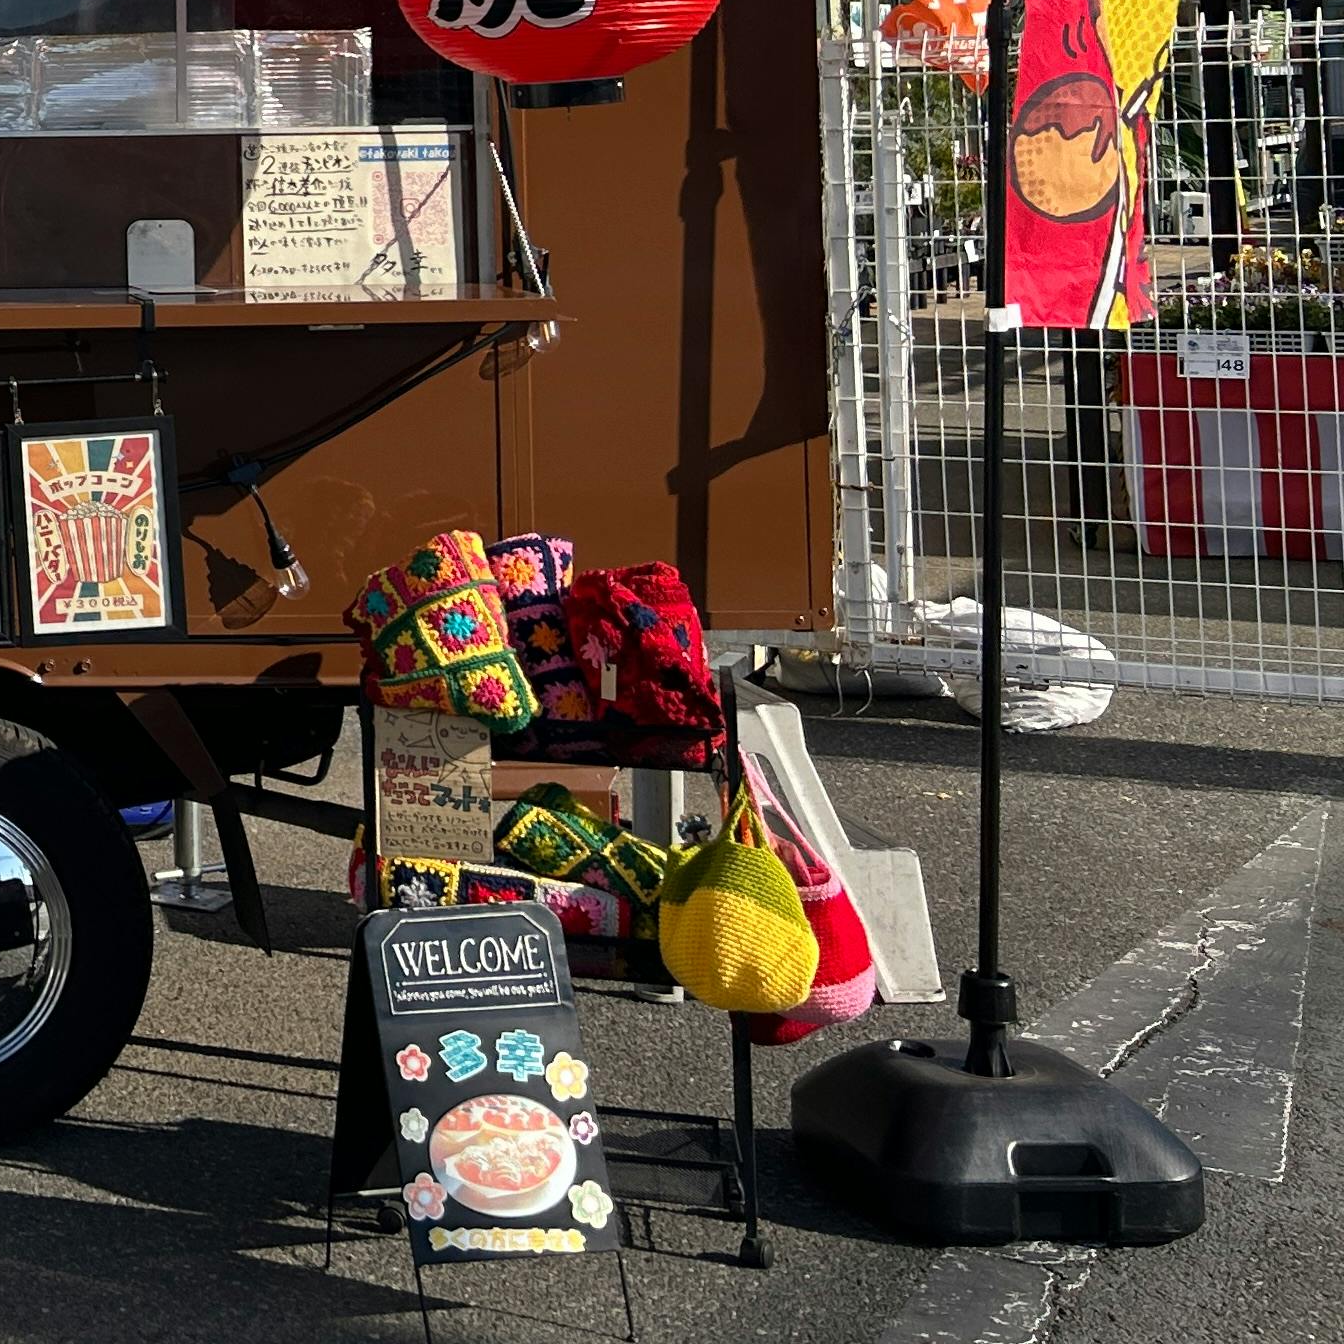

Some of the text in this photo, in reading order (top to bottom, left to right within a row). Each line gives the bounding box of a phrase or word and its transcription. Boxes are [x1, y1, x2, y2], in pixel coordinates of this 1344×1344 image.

[49, 475, 134, 494] ポップコーン
[36, 514, 62, 582] ハニーバター
[133, 513, 149, 570] のりしお
[391, 934, 544, 977] WELCOME
[438, 1029, 545, 1083] 多幸
